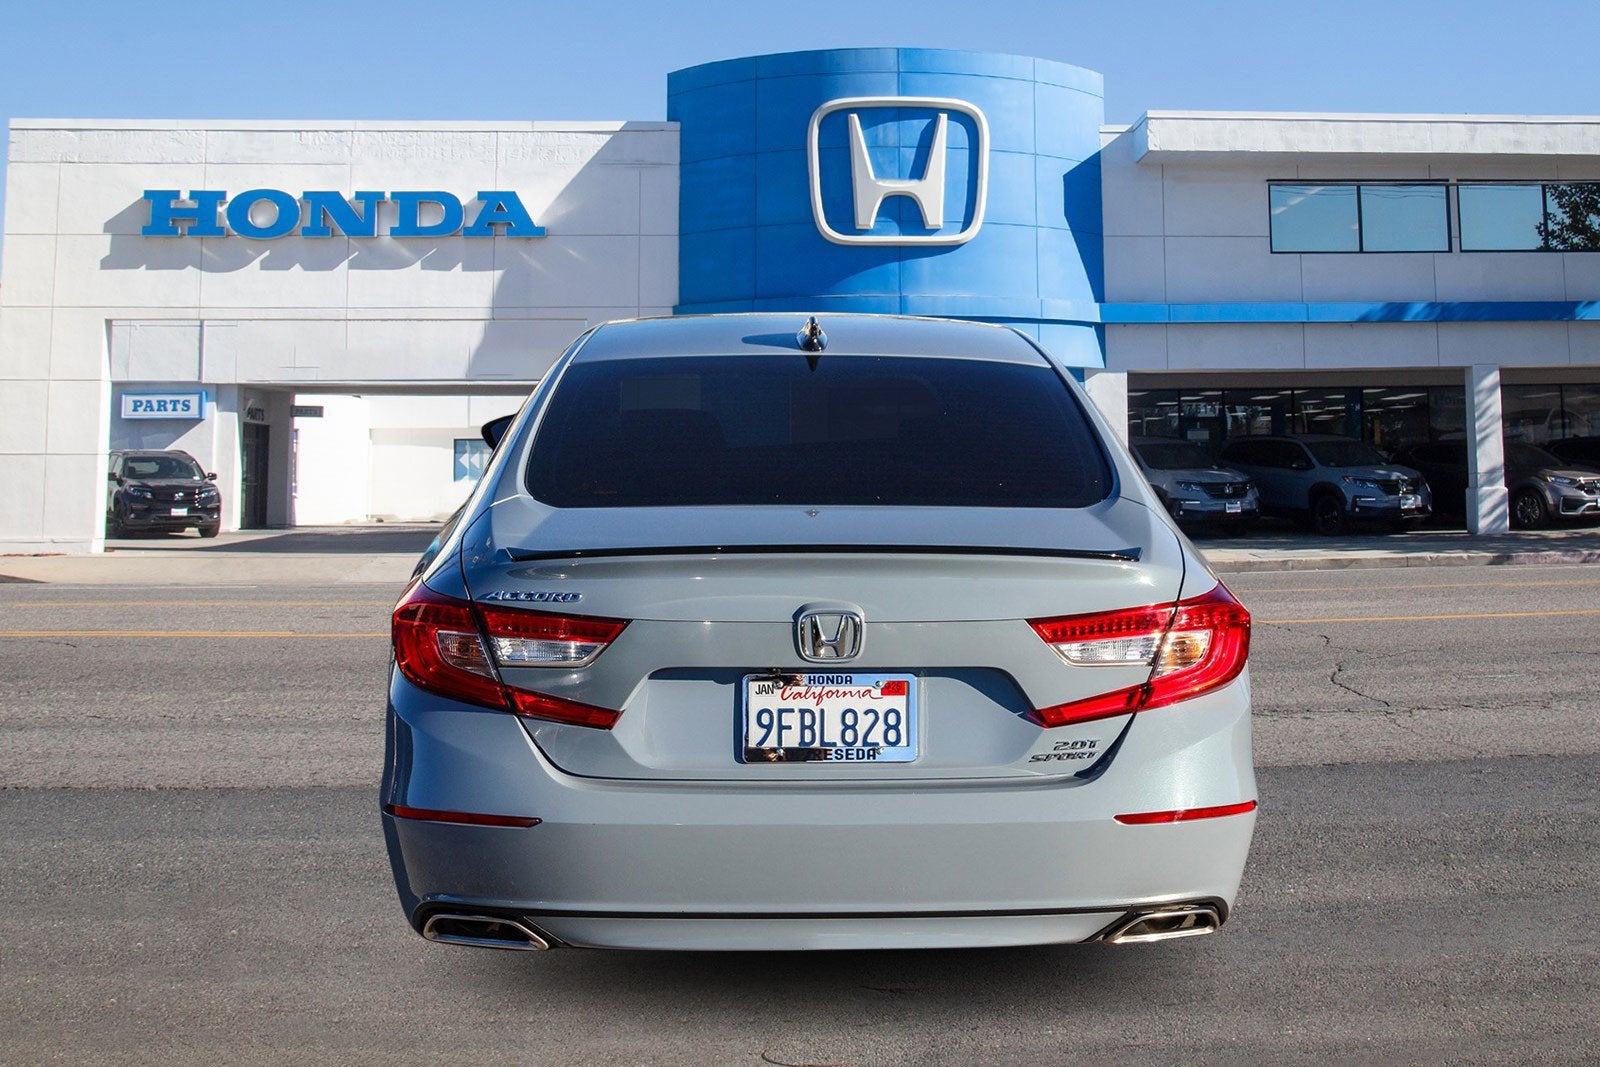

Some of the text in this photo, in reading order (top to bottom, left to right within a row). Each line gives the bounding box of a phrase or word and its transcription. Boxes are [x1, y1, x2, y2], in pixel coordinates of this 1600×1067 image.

[141, 189, 548, 239] HONDA
[132, 399, 191, 412] PARTS
[484, 590, 584, 602] ACCORD
[808, 675, 853, 685] HONDA
[755, 684, 774, 695] JAN
[781, 685, 883, 706] California
[756, 708, 902, 747] 9FBL828
[1028, 752, 1098, 762] SPORT
